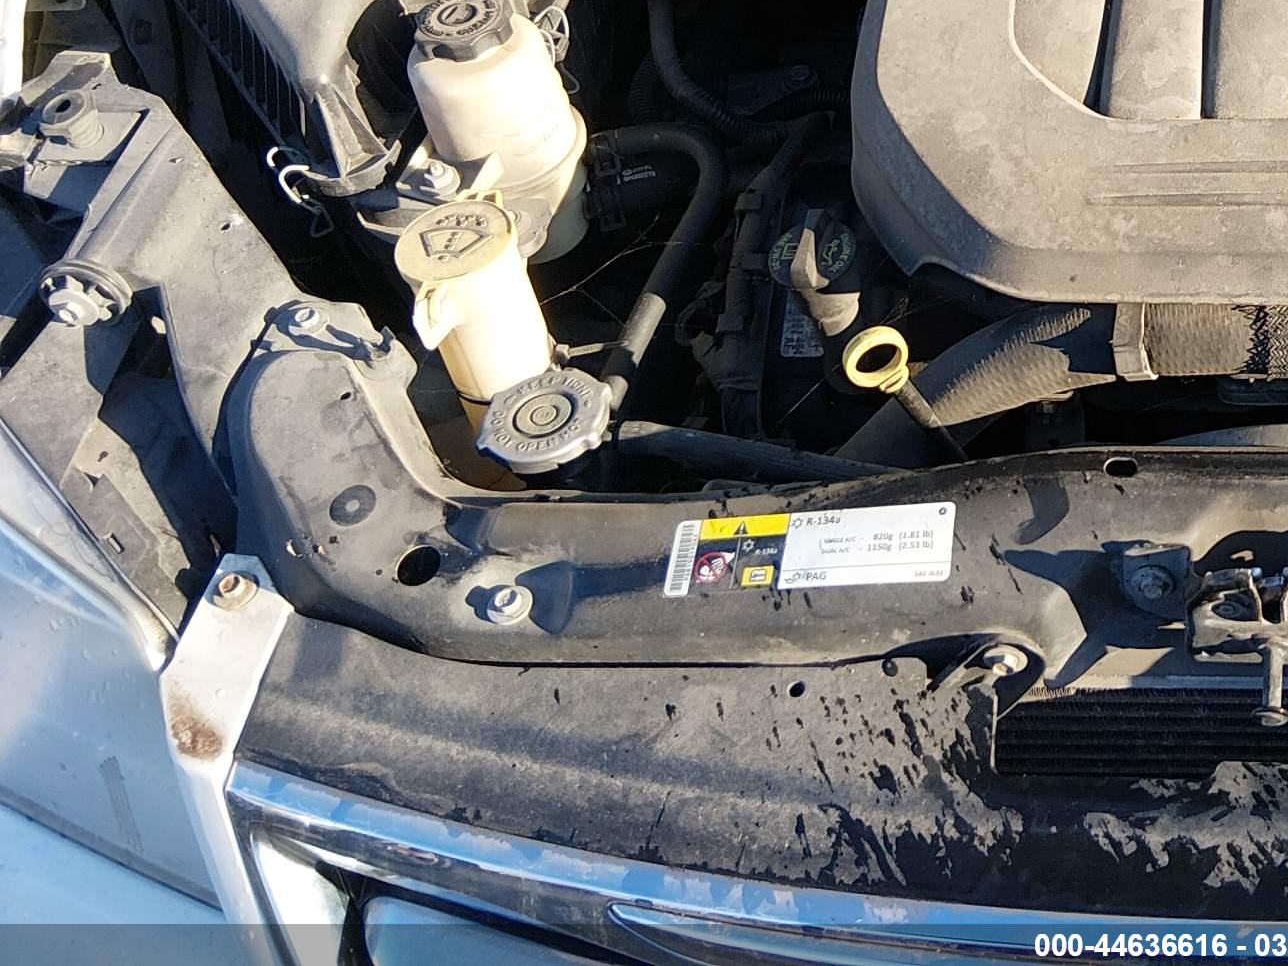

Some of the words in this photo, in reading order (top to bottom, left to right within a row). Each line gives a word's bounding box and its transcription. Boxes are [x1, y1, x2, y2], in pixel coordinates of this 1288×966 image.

[806, 516, 841, 527] R-134a
[867, 543, 893, 552] 1150g
[806, 571, 828, 581] PAG
